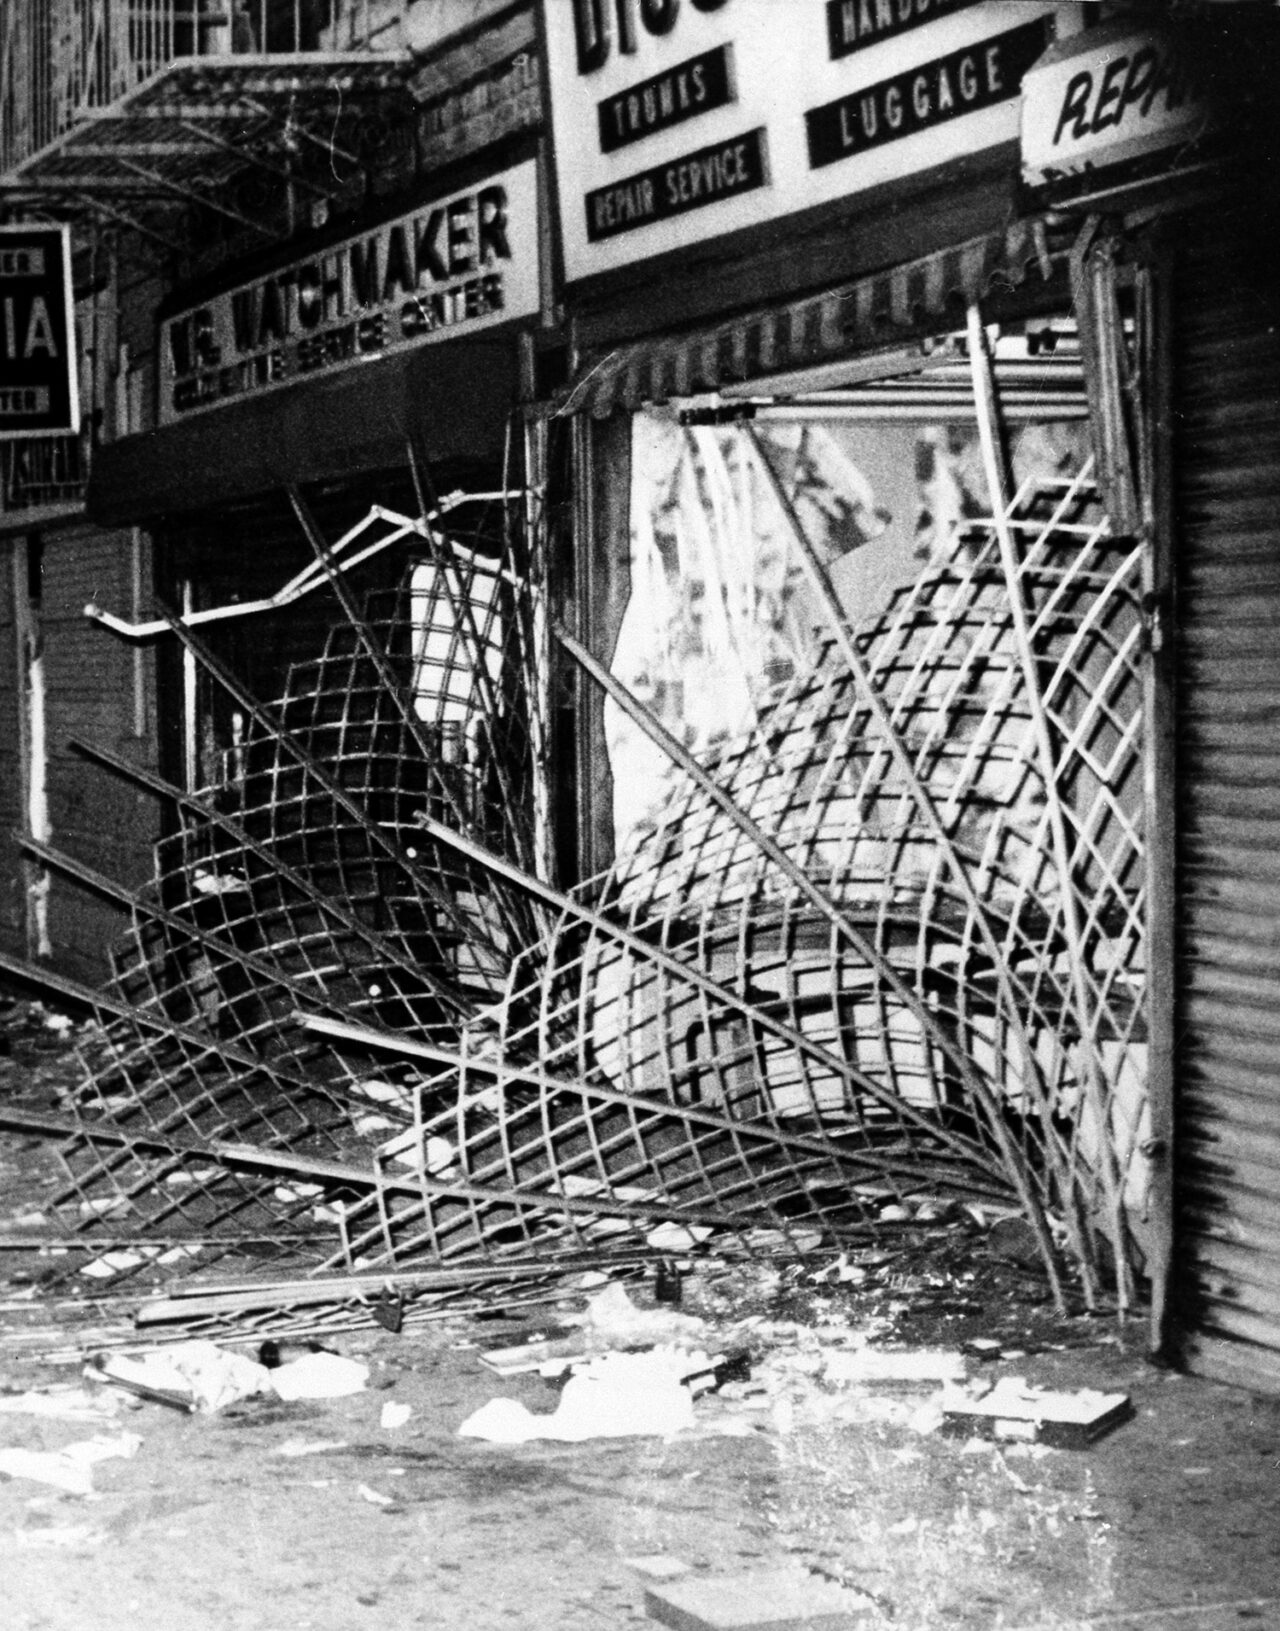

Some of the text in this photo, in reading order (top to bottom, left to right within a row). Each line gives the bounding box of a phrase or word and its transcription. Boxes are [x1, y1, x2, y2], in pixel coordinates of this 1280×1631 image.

[840, 46, 1003, 147] LUGGAGE
[594, 143, 749, 231] REPAIR SERVICE
[230, 186, 512, 354] WATCHMAKER
[401, 272, 505, 338] CENTER
